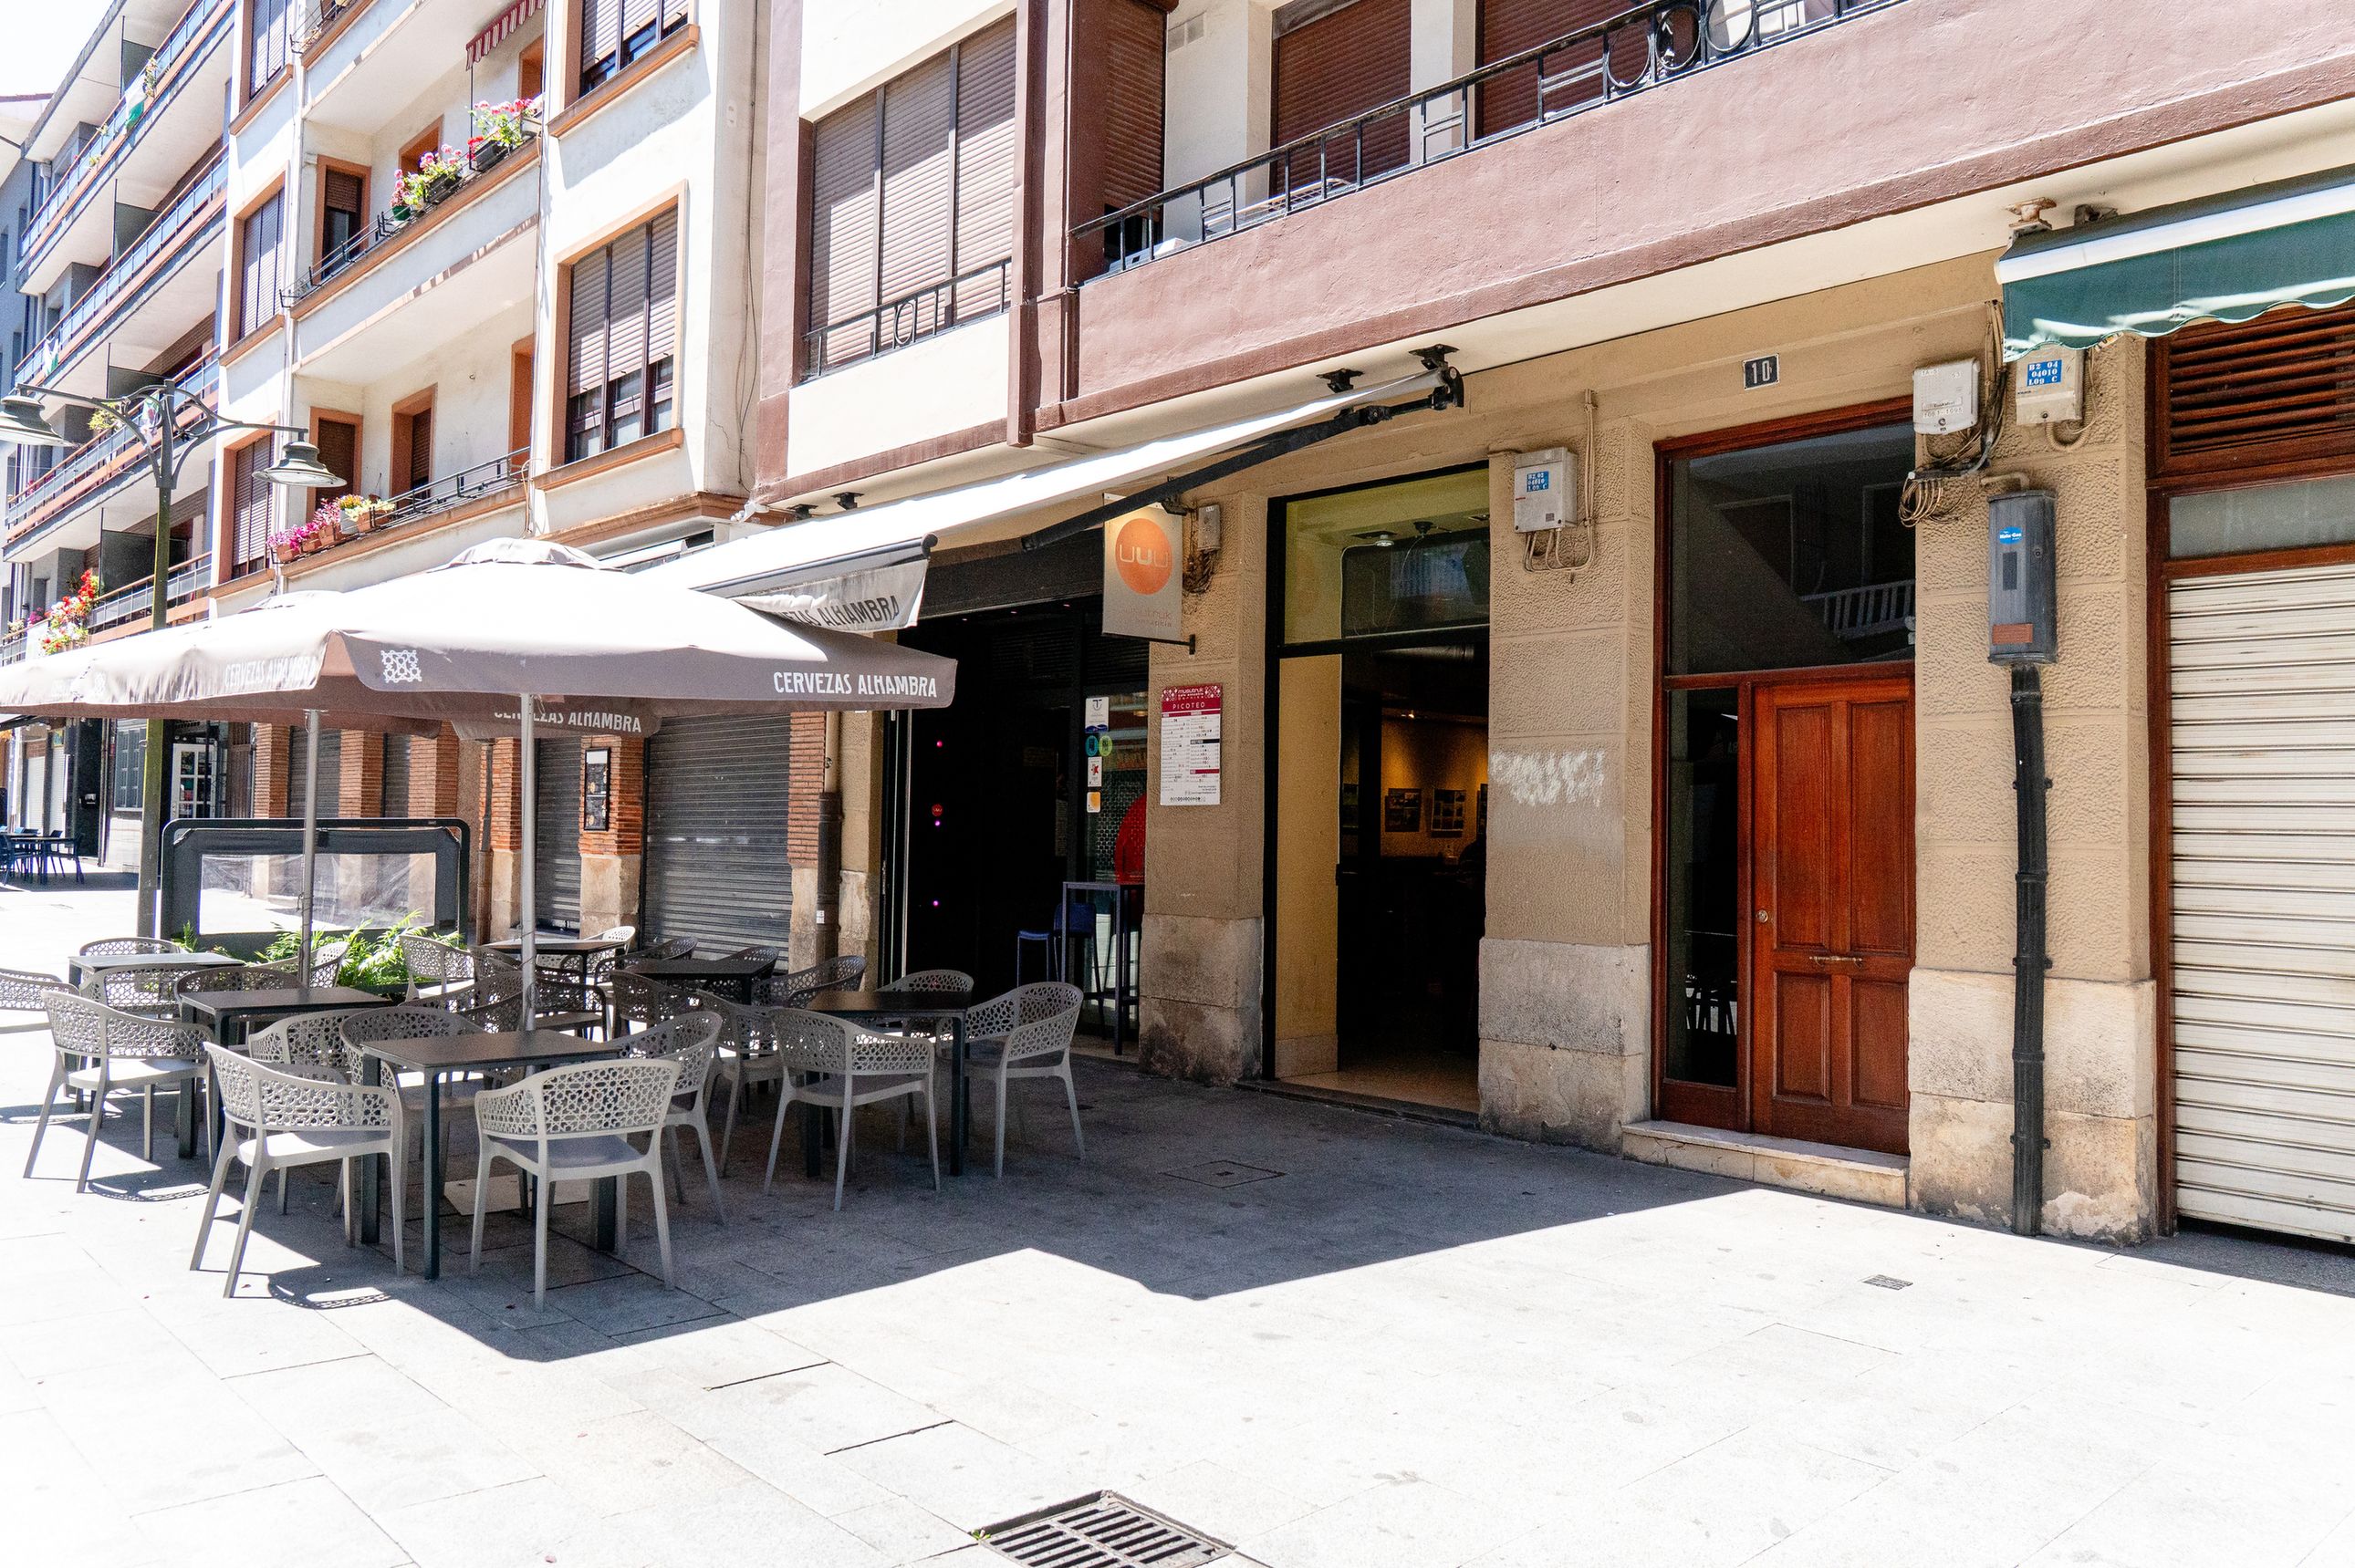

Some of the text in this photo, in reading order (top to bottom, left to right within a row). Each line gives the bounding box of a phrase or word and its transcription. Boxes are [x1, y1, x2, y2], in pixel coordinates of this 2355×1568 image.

[1752, 360, 1771, 383] 10
[2031, 368, 2058, 378] 04010
[2047, 360, 2058, 369] 04
[817, 595, 901, 628] ALHAMBRA
[773, 671, 937, 698] CERVEZAS ALHAMBRA
[1172, 701, 1205, 710] PICOTEO
[568, 711, 641, 732] ALHAMBRA
